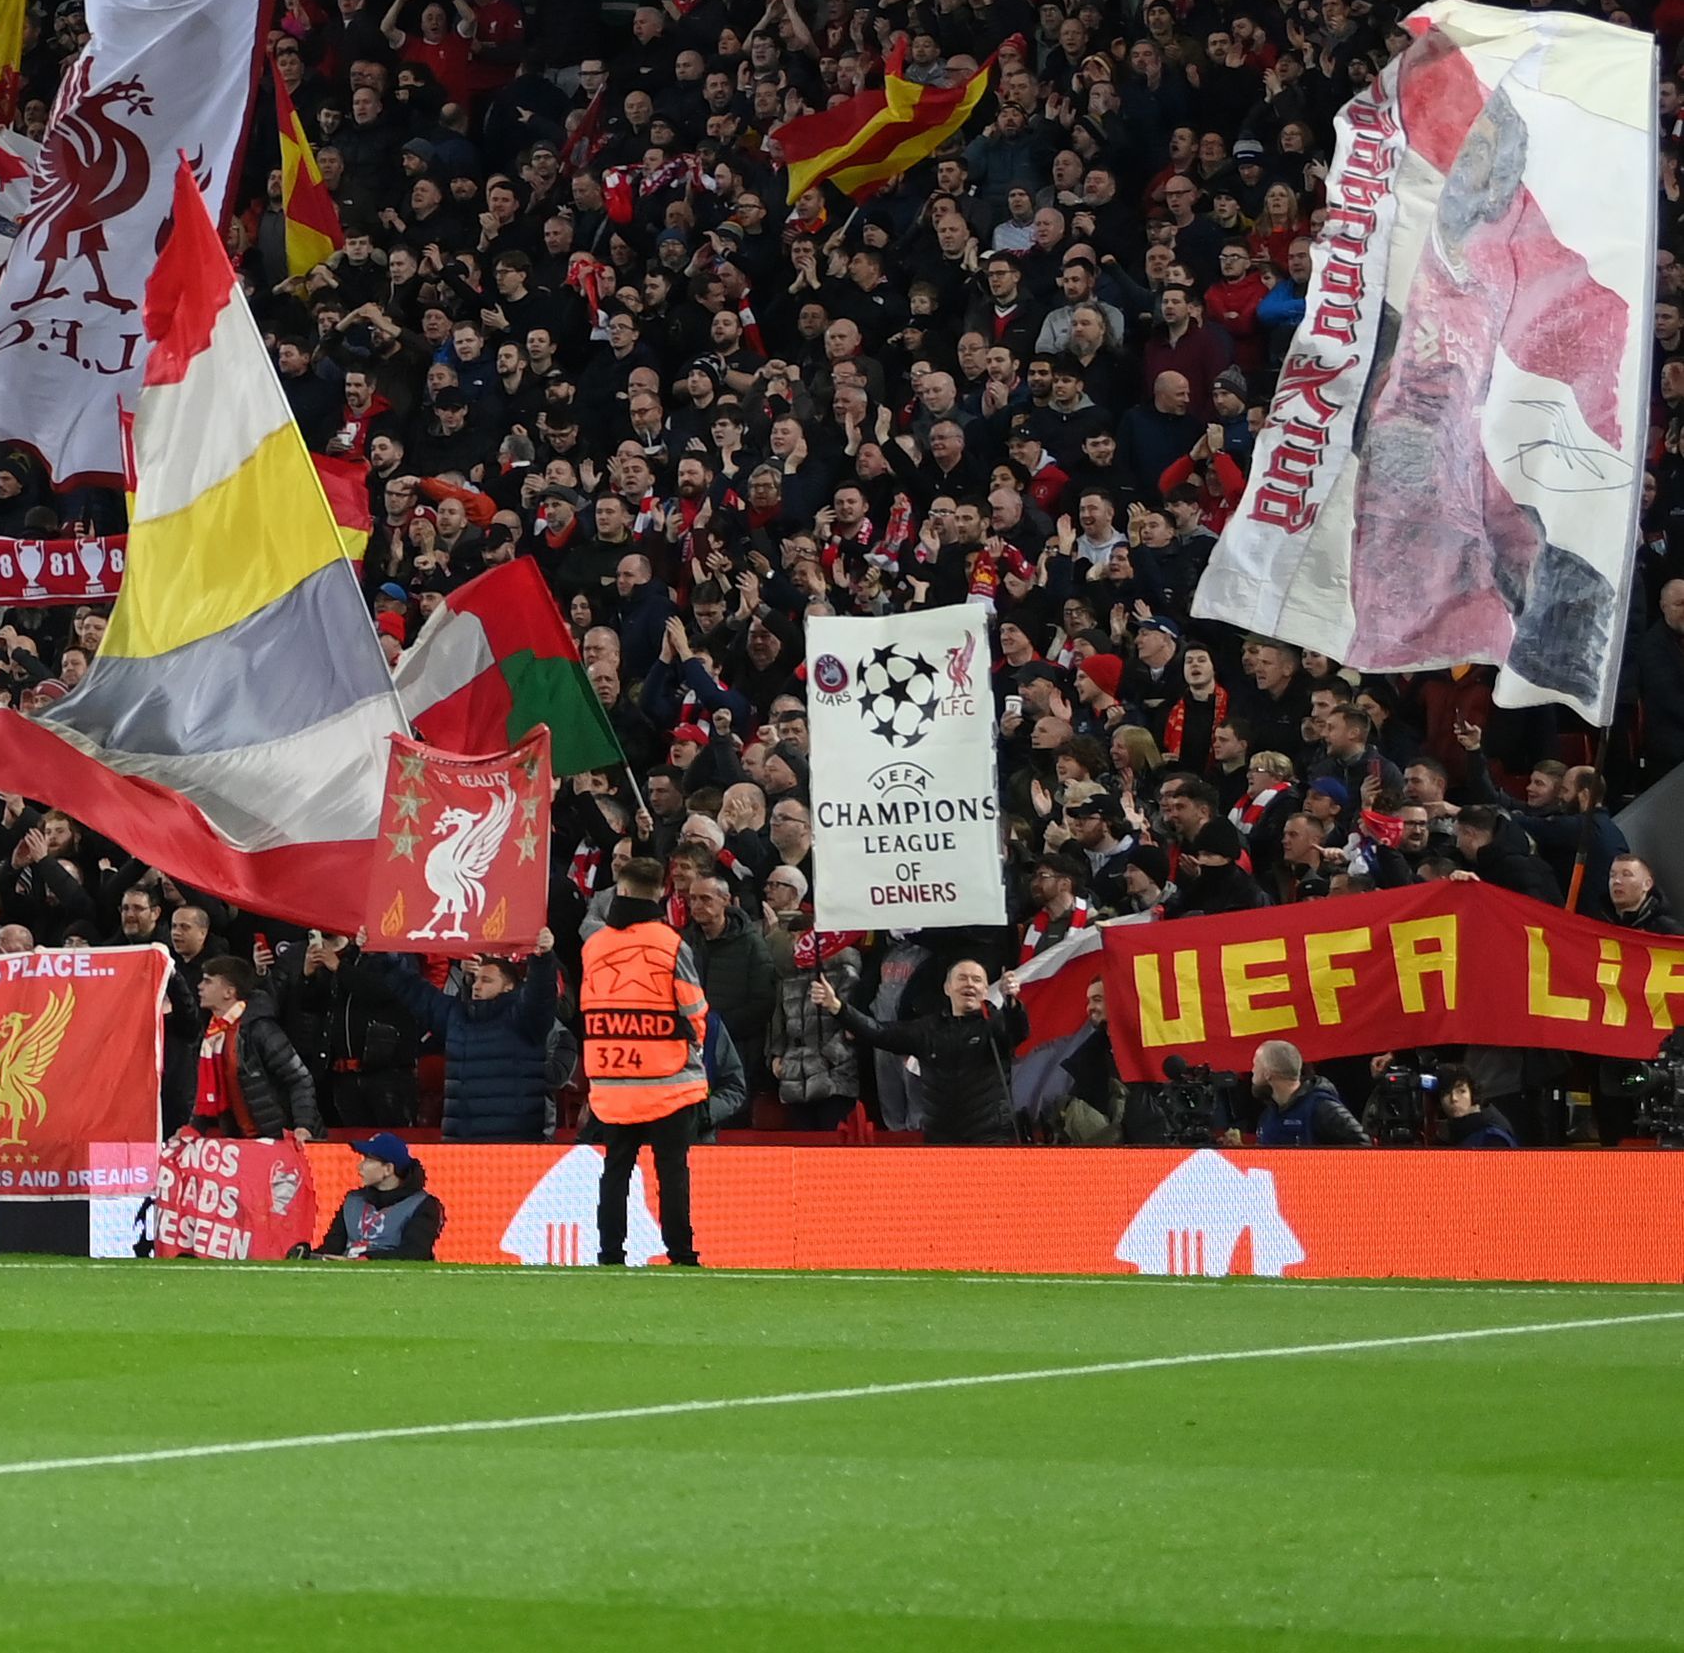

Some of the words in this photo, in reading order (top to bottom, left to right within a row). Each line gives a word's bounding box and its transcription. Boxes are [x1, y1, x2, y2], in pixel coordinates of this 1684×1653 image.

[49, 552, 76, 577] 81
[108, 548, 125, 573] 8
[815, 692, 853, 708] LIARS
[458, 770, 510, 789] REALITY
[872, 768, 928, 792] UEFA
[818, 795, 996, 829] CHAMPIONS
[863, 831, 956, 854] LEAGUE
[895, 862, 922, 882] OF
[870, 882, 958, 906] DENIERS
[6, 954, 116, 981] PLACE...
[1132, 914, 1459, 1048] UEFA
[585, 1012, 676, 1037] TEWARD
[596, 1046, 643, 1069] 324
[18, 1169, 61, 1188] AND
[66, 1167, 149, 1188] DREAMS
[157, 1165, 241, 1219] RADS
